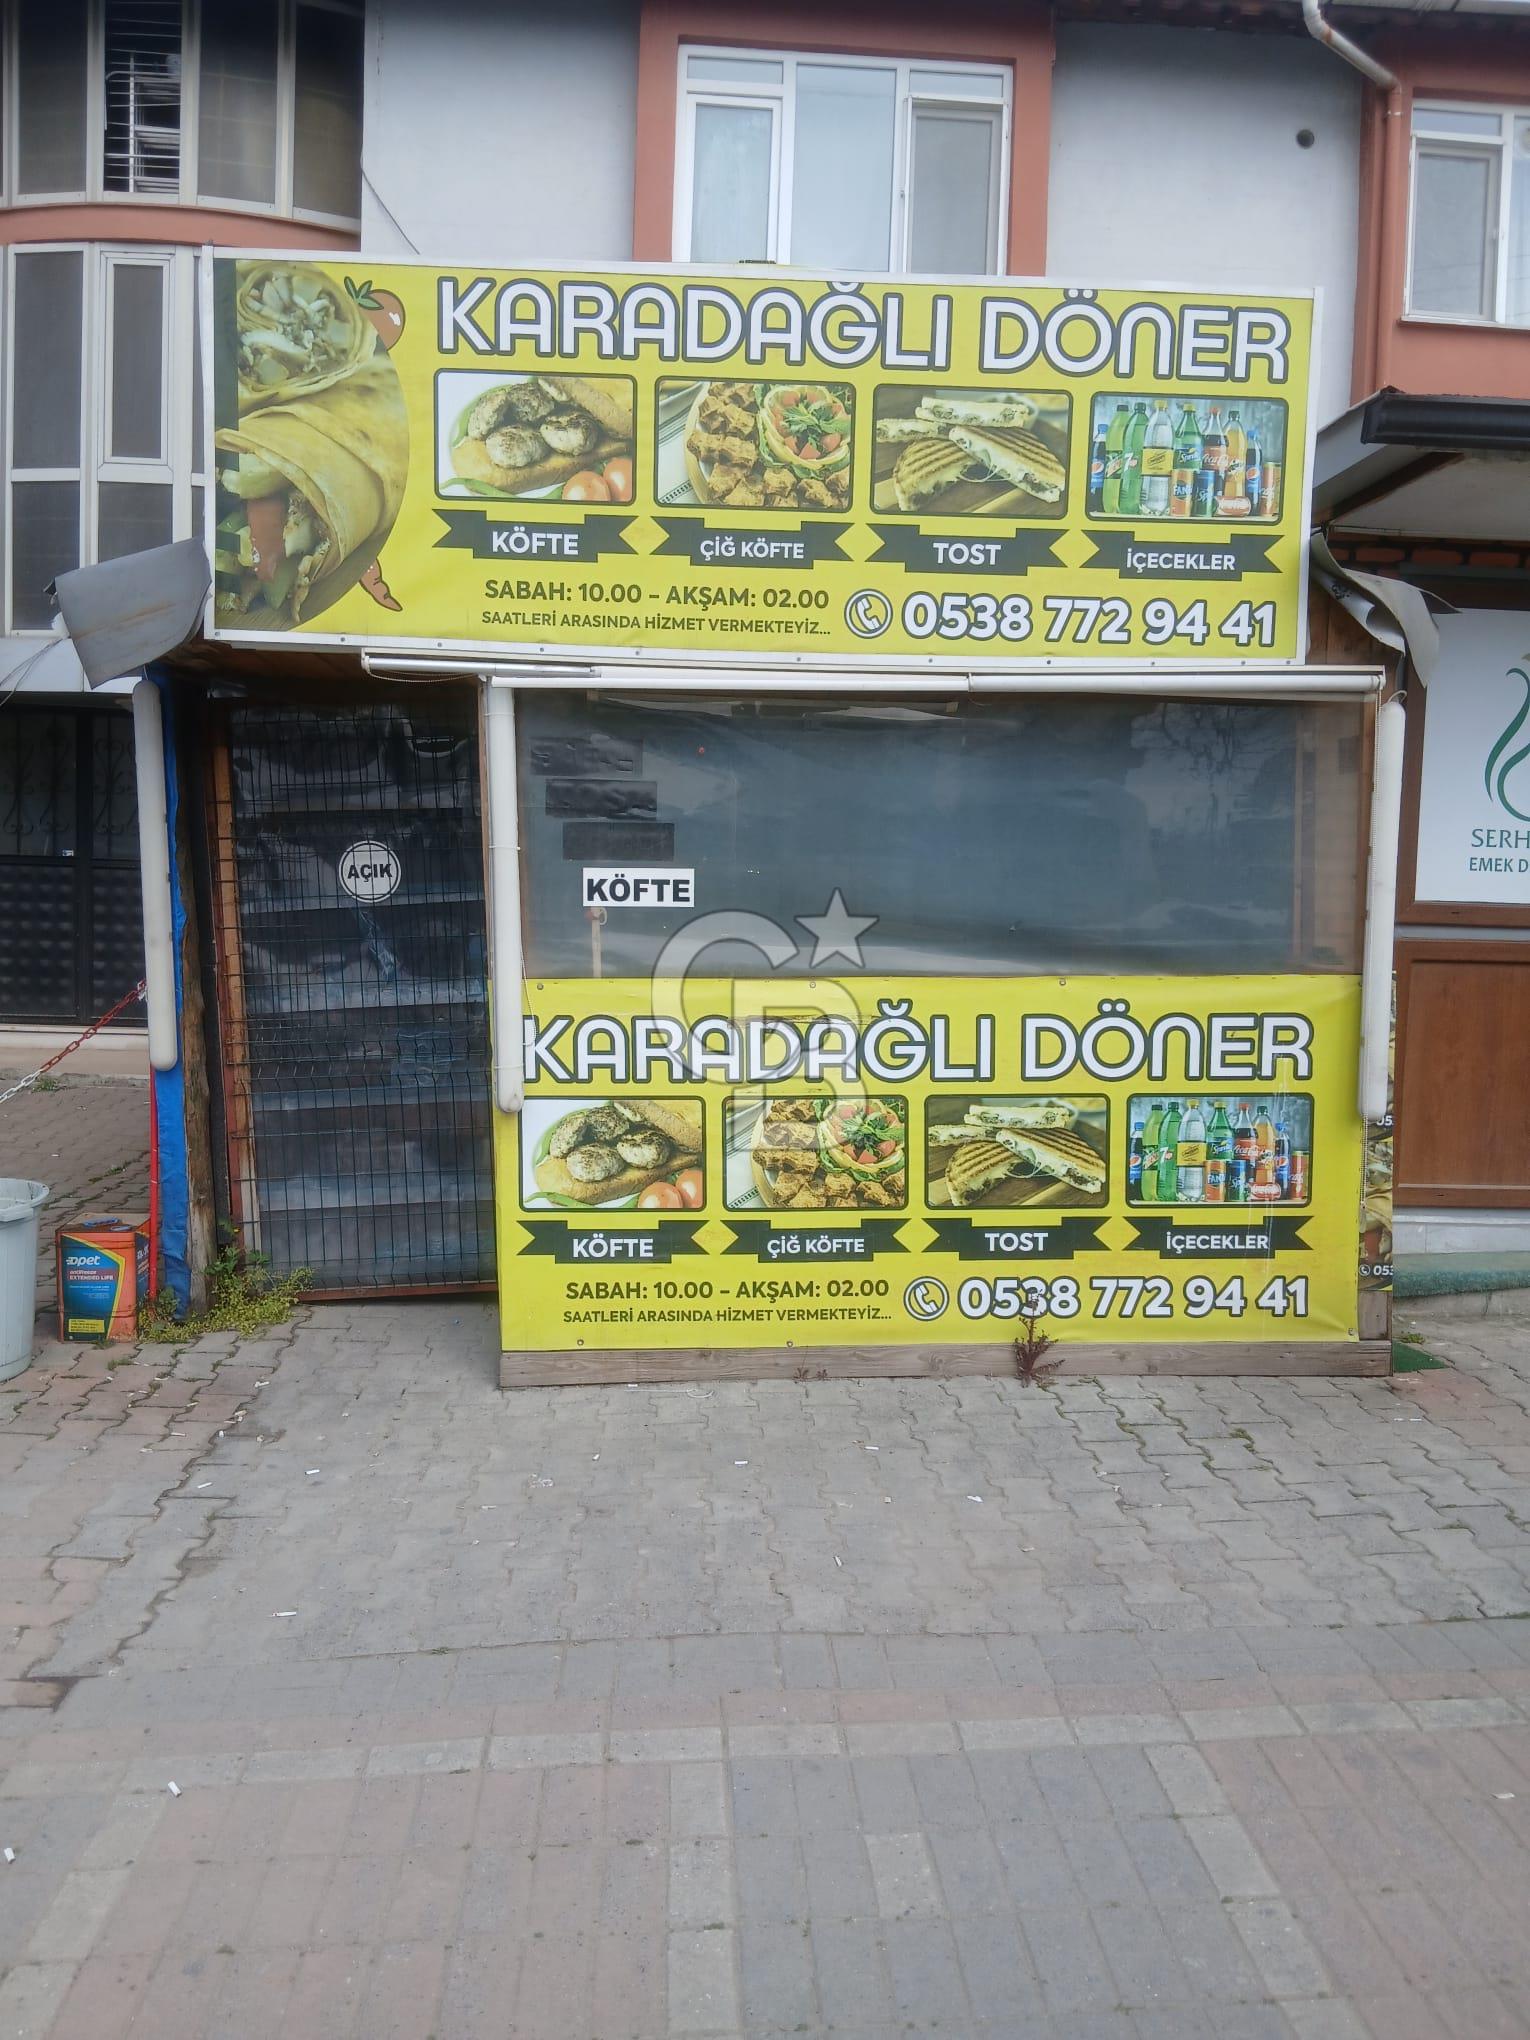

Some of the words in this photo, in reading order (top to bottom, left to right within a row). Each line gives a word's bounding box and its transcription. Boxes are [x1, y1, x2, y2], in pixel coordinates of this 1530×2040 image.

[437, 276, 954, 371] KARADAĞLI
[979, 288, 1291, 384] DÖNER
[492, 526, 579, 556] KÖFTE
[700, 538, 736, 561] ÇİĞ
[741, 539, 805, 560] KÖFTE
[933, 543, 1001, 566] TOST
[1126, 547, 1236, 573] İÇECEKLER
[485, 579, 572, 601] SABAH:
[578, 583, 642, 603] 10.00
[666, 585, 756, 611] AKŞAM:
[763, 588, 829, 609] 02.00
[482, 610, 556, 627] SAATLERİ
[560, 613, 641, 629] ARASINDA
[644, 612, 705, 631] HİZMET
[709, 617, 831, 635] VERMEKTEYİZ...
[902, 592, 1033, 642] 0538
[1044, 594, 1131, 644] 772
[1142, 597, 1208, 646] 94
[1219, 601, 1276, 648] 41
[1471, 828, 1530, 849] SERH
[347, 863, 392, 883] AÇIK
[1469, 857, 1513, 872] EMEK
[587, 873, 691, 903] KÖFTE
[522, 998, 996, 1085] KARADAĞLI
[1021, 998, 1314, 1083] DÖNER
[572, 1233, 654, 1259] KÖFTE
[767, 1237, 801, 1260] ÇİĞ
[805, 1235, 865, 1254] KÖFTE
[985, 1232, 1049, 1252] TOST
[1165, 1231, 1269, 1255] İÇECEKLER
[566, 1281, 648, 1299] SABAH:
[653, 1281, 713, 1299] 10.00
[736, 1280, 820, 1304] AKŞAM:
[827, 1279, 889, 1297] 02.00
[957, 1276, 1081, 1320] 0538
[1090, 1276, 1173, 1318] 772
[1183, 1276, 1246, 1319] 94
[1257, 1276, 1308, 1318] 41
[563, 1307, 633, 1323] SAATLERİ
[637, 1309, 713, 1322] ARASINDA
[716, 1306, 773, 1321] HİZMET
[776, 1305, 892, 1321] VERMEKTEYİZ...
